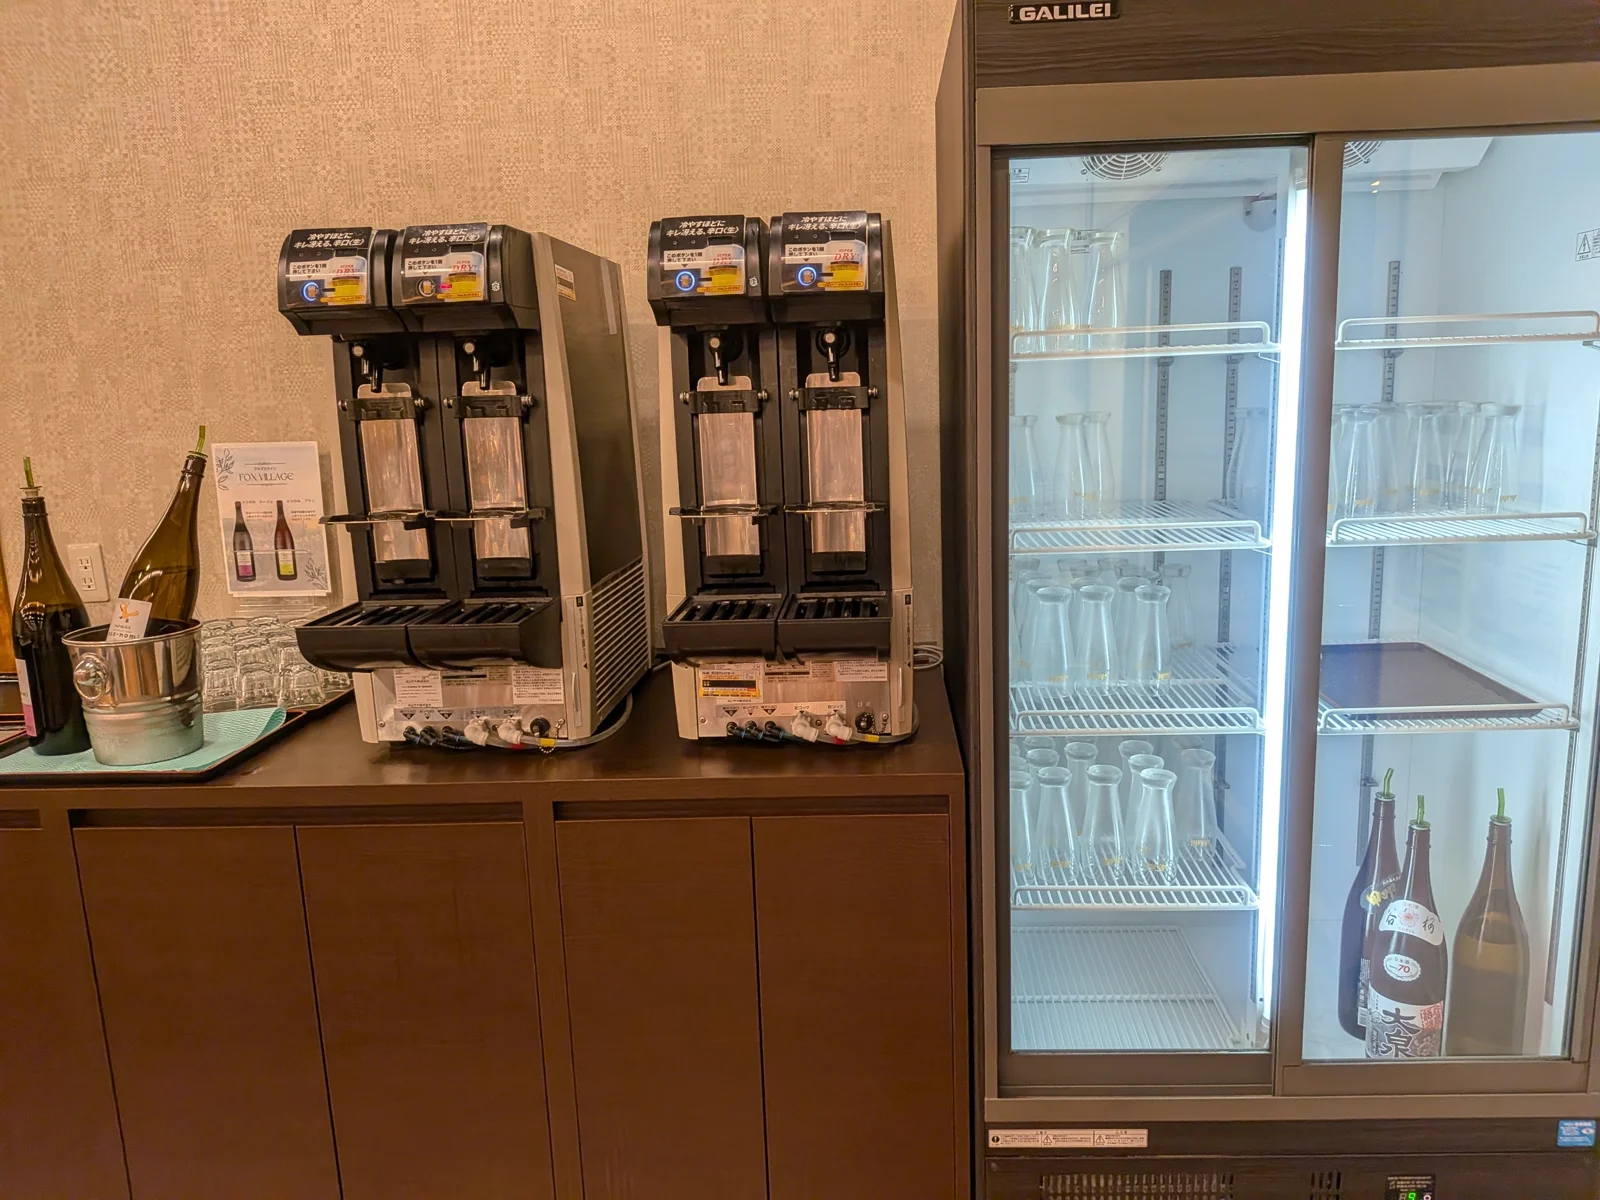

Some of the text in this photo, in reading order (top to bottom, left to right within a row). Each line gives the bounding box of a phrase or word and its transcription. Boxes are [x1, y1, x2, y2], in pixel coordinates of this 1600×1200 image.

[1020, 3, 1111, 21] GALILEI
[679, 219, 727, 228] 冷やすほどに
[801, 215, 848, 223] 冷やすほどに
[307, 232, 354, 241] 冷やすほどに
[422, 228, 469, 237] 冷やすほどに
[239, 472, 294, 481] FOX VILLAGE
[1397, 964, 1411, 974] 70
